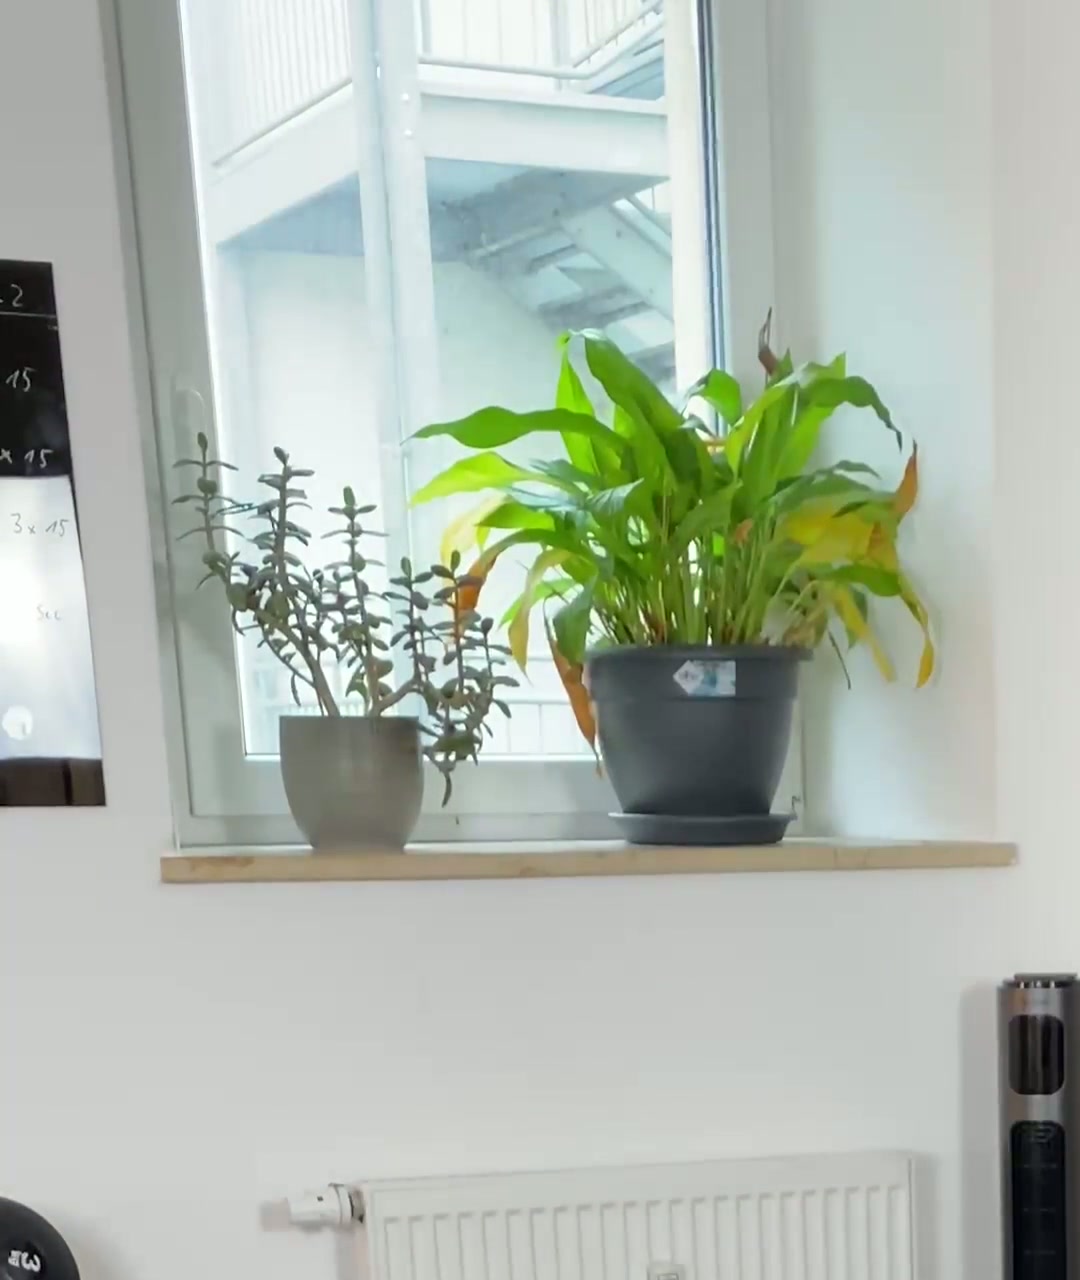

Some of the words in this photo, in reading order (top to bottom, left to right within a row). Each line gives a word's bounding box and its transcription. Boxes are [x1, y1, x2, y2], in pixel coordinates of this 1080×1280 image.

[10, 283, 24, 307] 2
[5, 366, 37, 392] 15
[24, 448, 54, 469] 15
